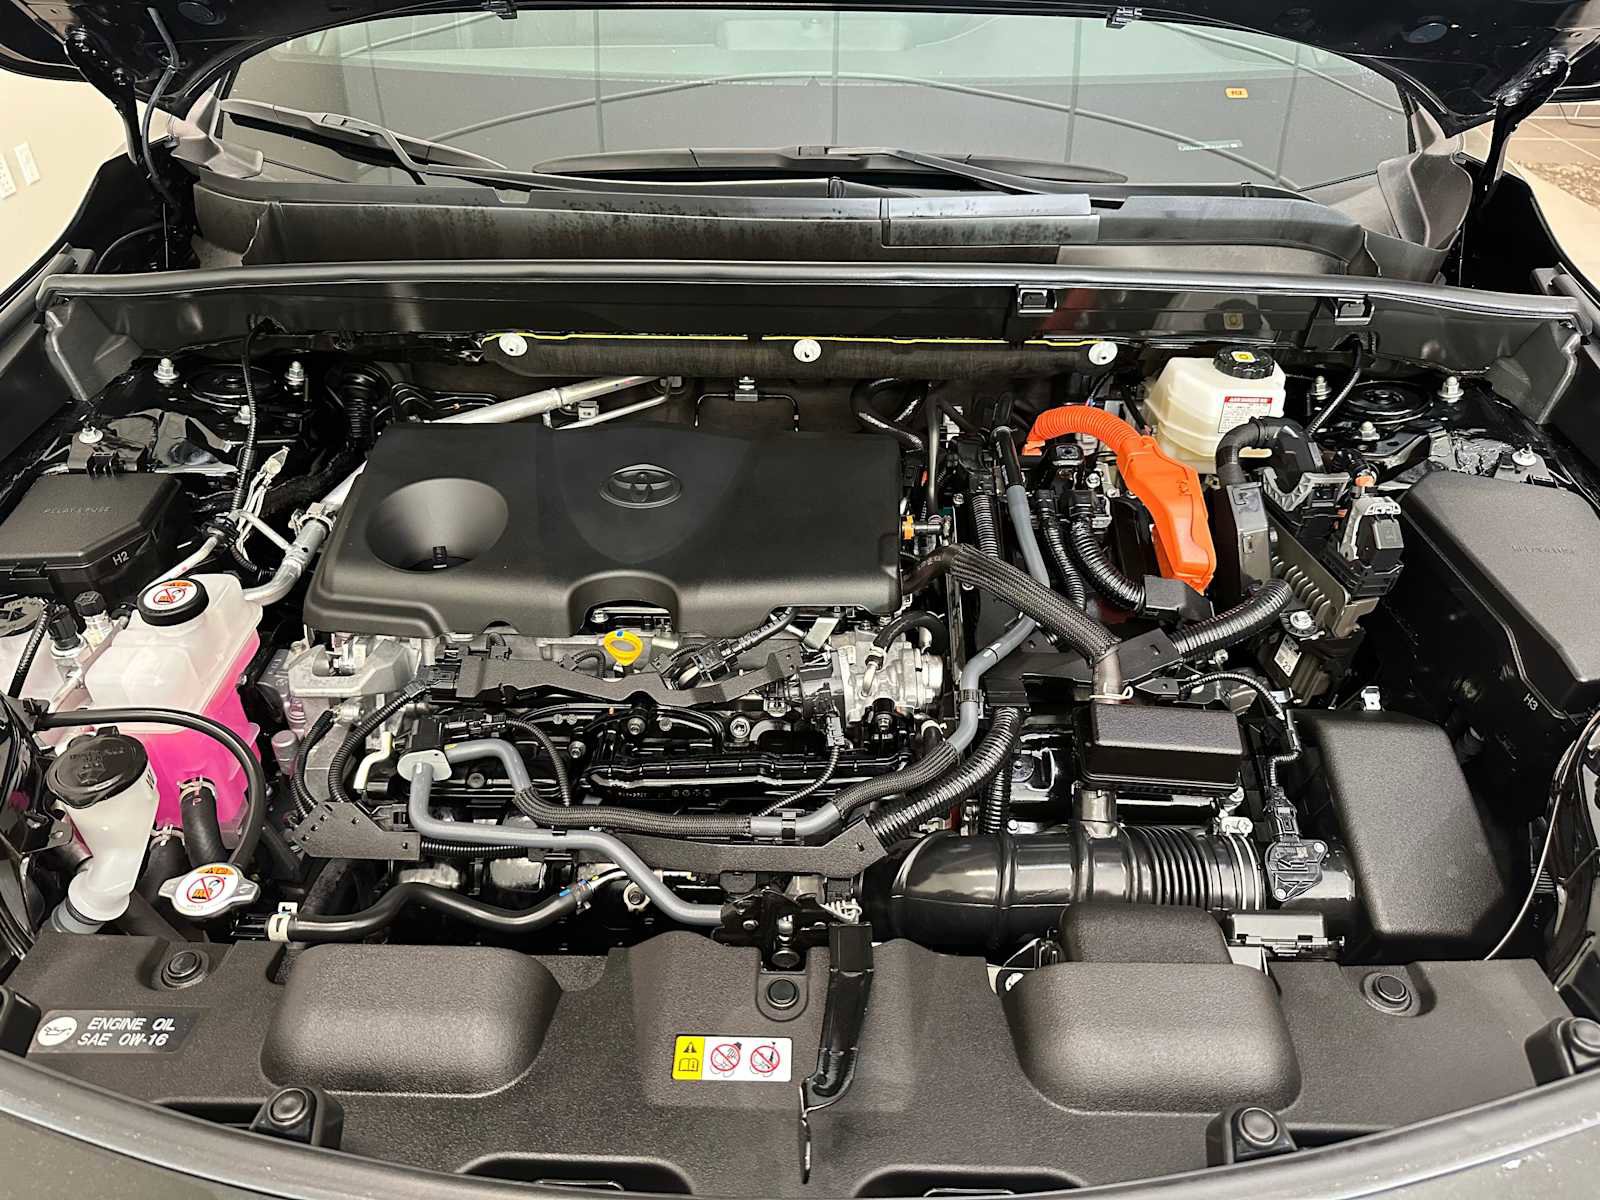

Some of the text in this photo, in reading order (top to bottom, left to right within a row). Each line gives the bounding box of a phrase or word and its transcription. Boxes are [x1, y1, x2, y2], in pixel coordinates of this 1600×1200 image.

[112, 551, 130, 566] H2
[1523, 693, 1538, 711] H3
[87, 1017, 176, 1032] ENGINE OIL
[77, 1033, 112, 1047] SAE
